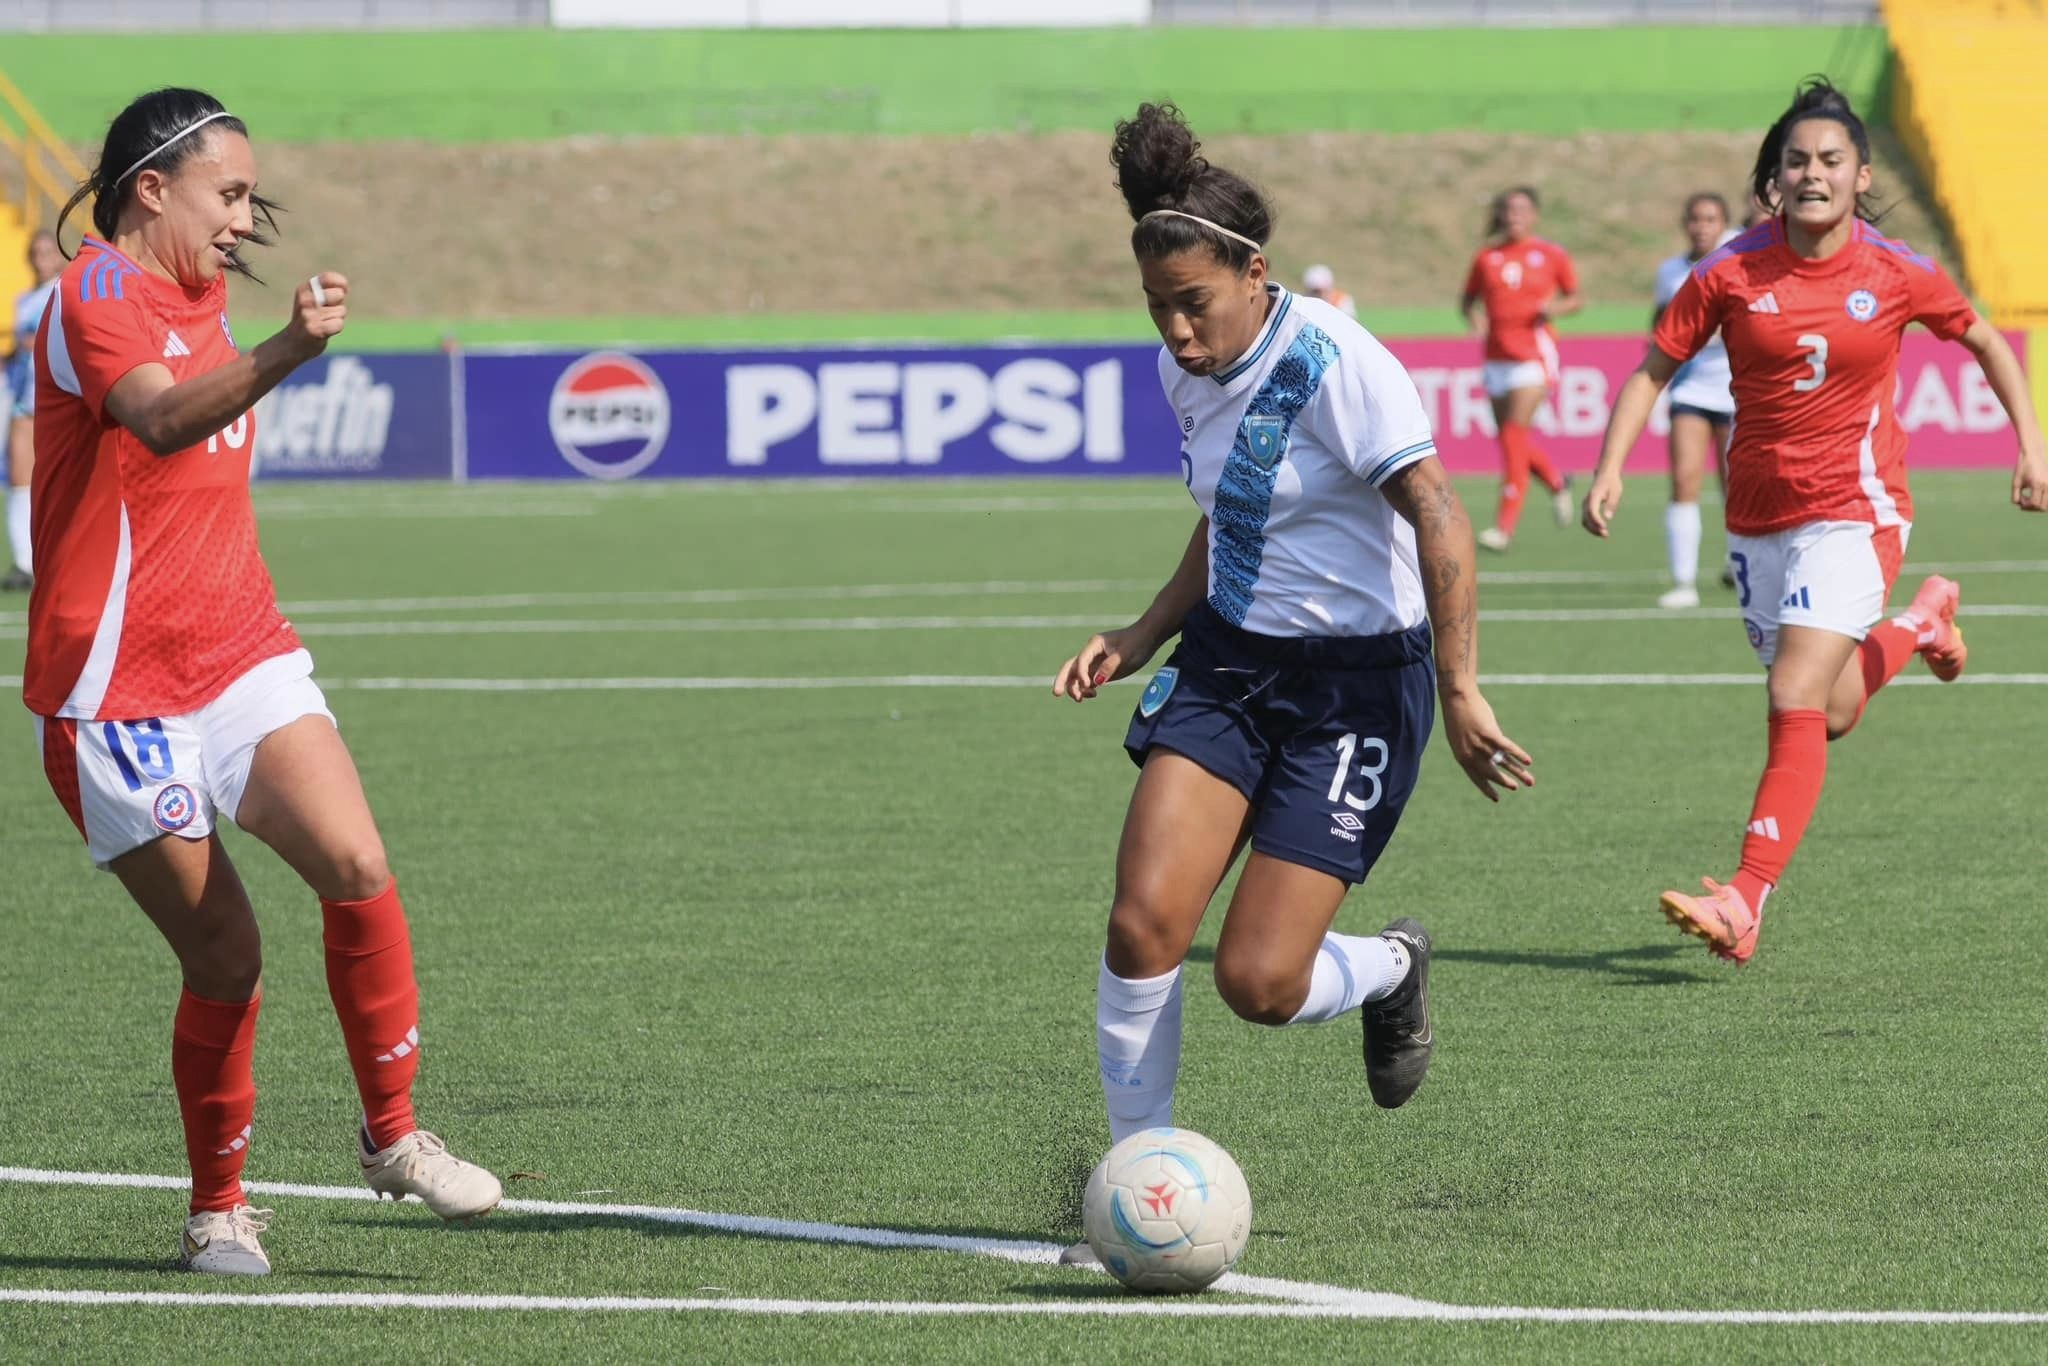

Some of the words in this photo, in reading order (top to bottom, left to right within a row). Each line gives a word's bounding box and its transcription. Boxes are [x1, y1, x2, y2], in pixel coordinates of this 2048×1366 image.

[1793, 333, 1829, 392] 3
[564, 403, 655, 425] PEPSI
[725, 357, 1125, 466] PEPSI
[103, 717, 174, 793] 18
[1327, 732, 1389, 811] 13
[1330, 826, 1356, 842] umbro
